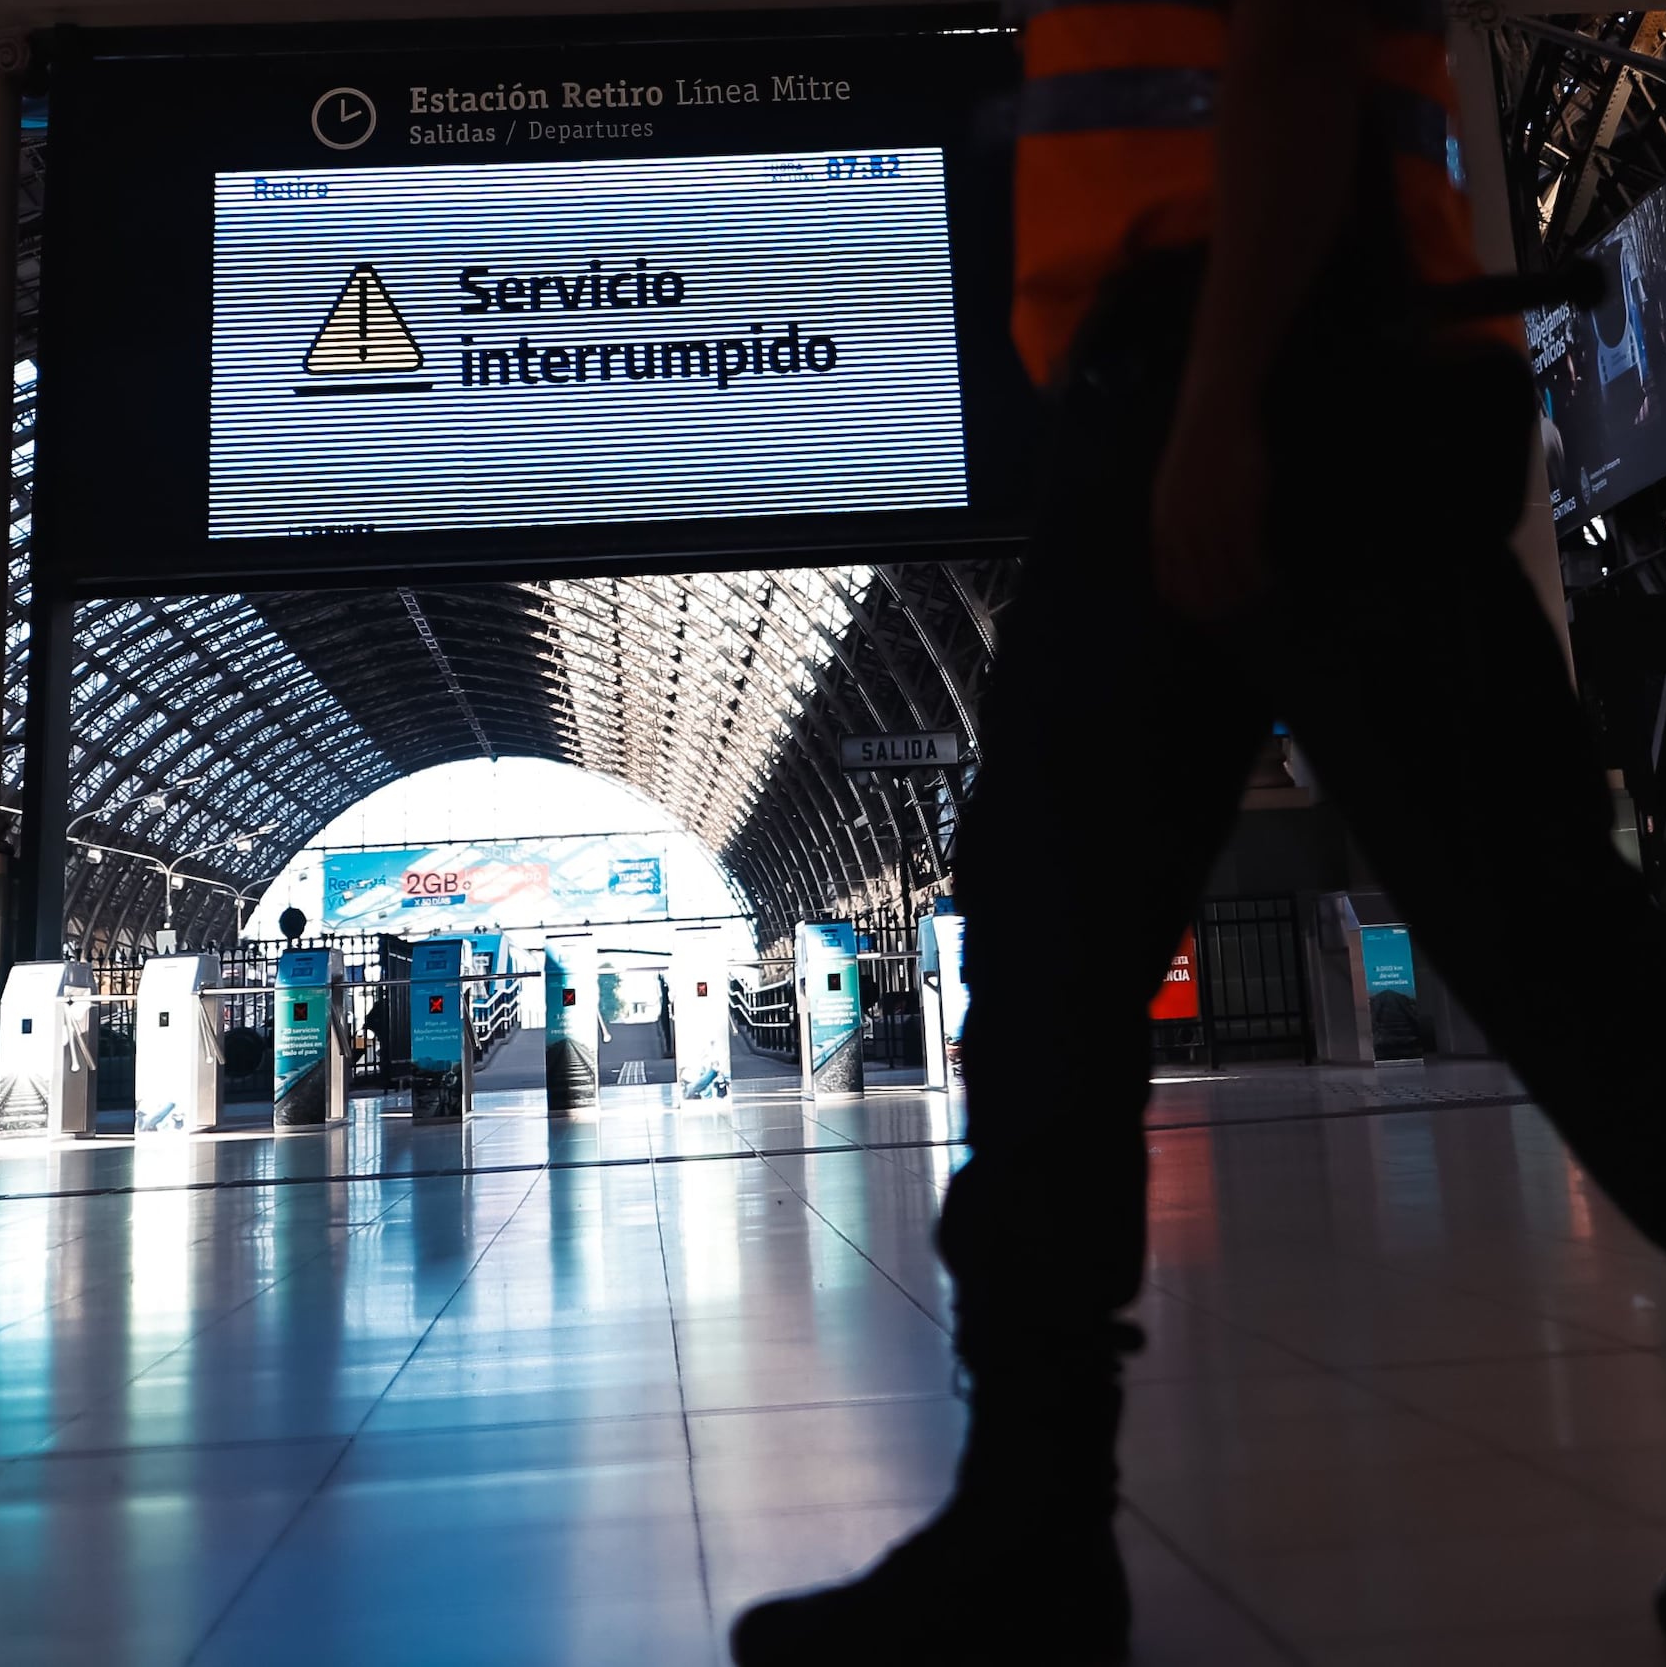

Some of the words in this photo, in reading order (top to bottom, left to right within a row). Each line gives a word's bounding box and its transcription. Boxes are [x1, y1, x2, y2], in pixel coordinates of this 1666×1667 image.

[409, 83, 550, 114] Estación
[562, 80, 664, 109] Retiro
[676, 78, 760, 106] Línea
[771, 74, 851, 102] Mitre
[409, 123, 496, 145] Salidas
[528, 118, 654, 144] Departures
[254, 177, 329, 200] Retiro
[460, 258, 685, 315] Servicio
[461, 321, 837, 391] interrumpido
[861, 738, 939, 762] SALIDA
[406, 872, 459, 895] 2GB
[1163, 968, 1190, 982] NCIA
